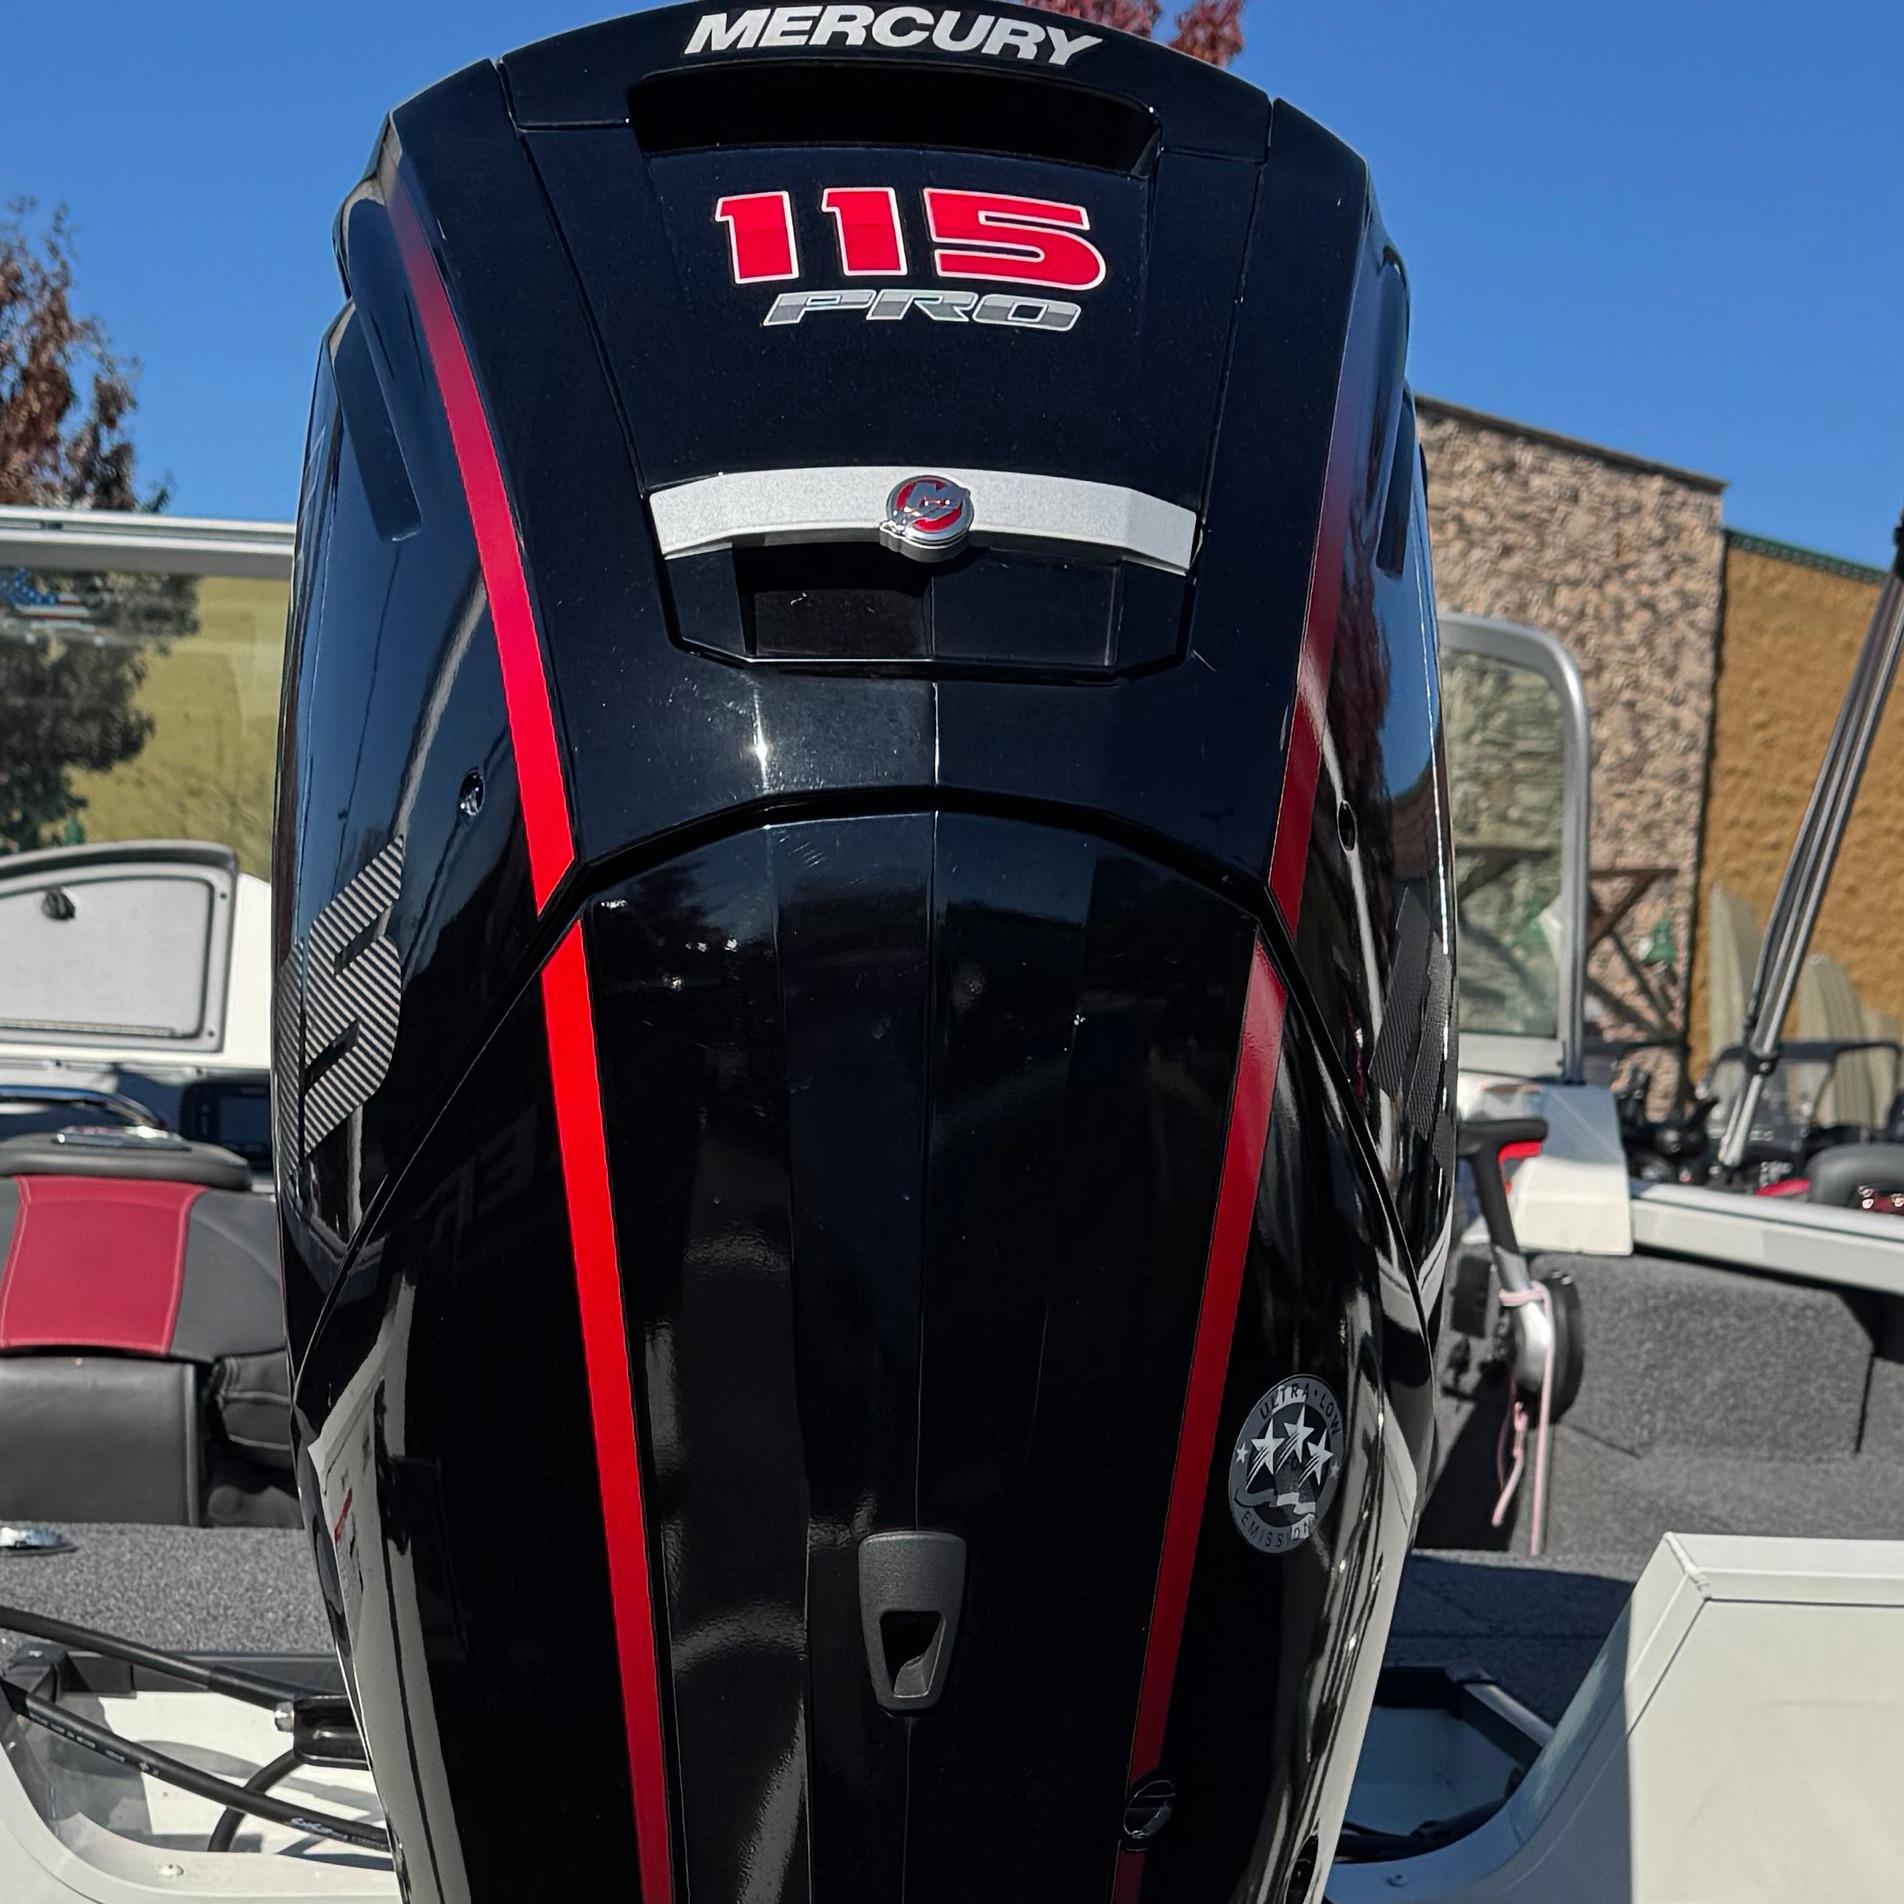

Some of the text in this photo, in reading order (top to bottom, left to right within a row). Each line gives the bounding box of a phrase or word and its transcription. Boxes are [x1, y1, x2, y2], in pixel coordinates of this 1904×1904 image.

[683, 5, 1105, 66] MERCURY
[715, 187, 1106, 291] 115
[763, 289, 1082, 331] PRO
[1259, 1383, 1342, 1435] ULTRA LOW
